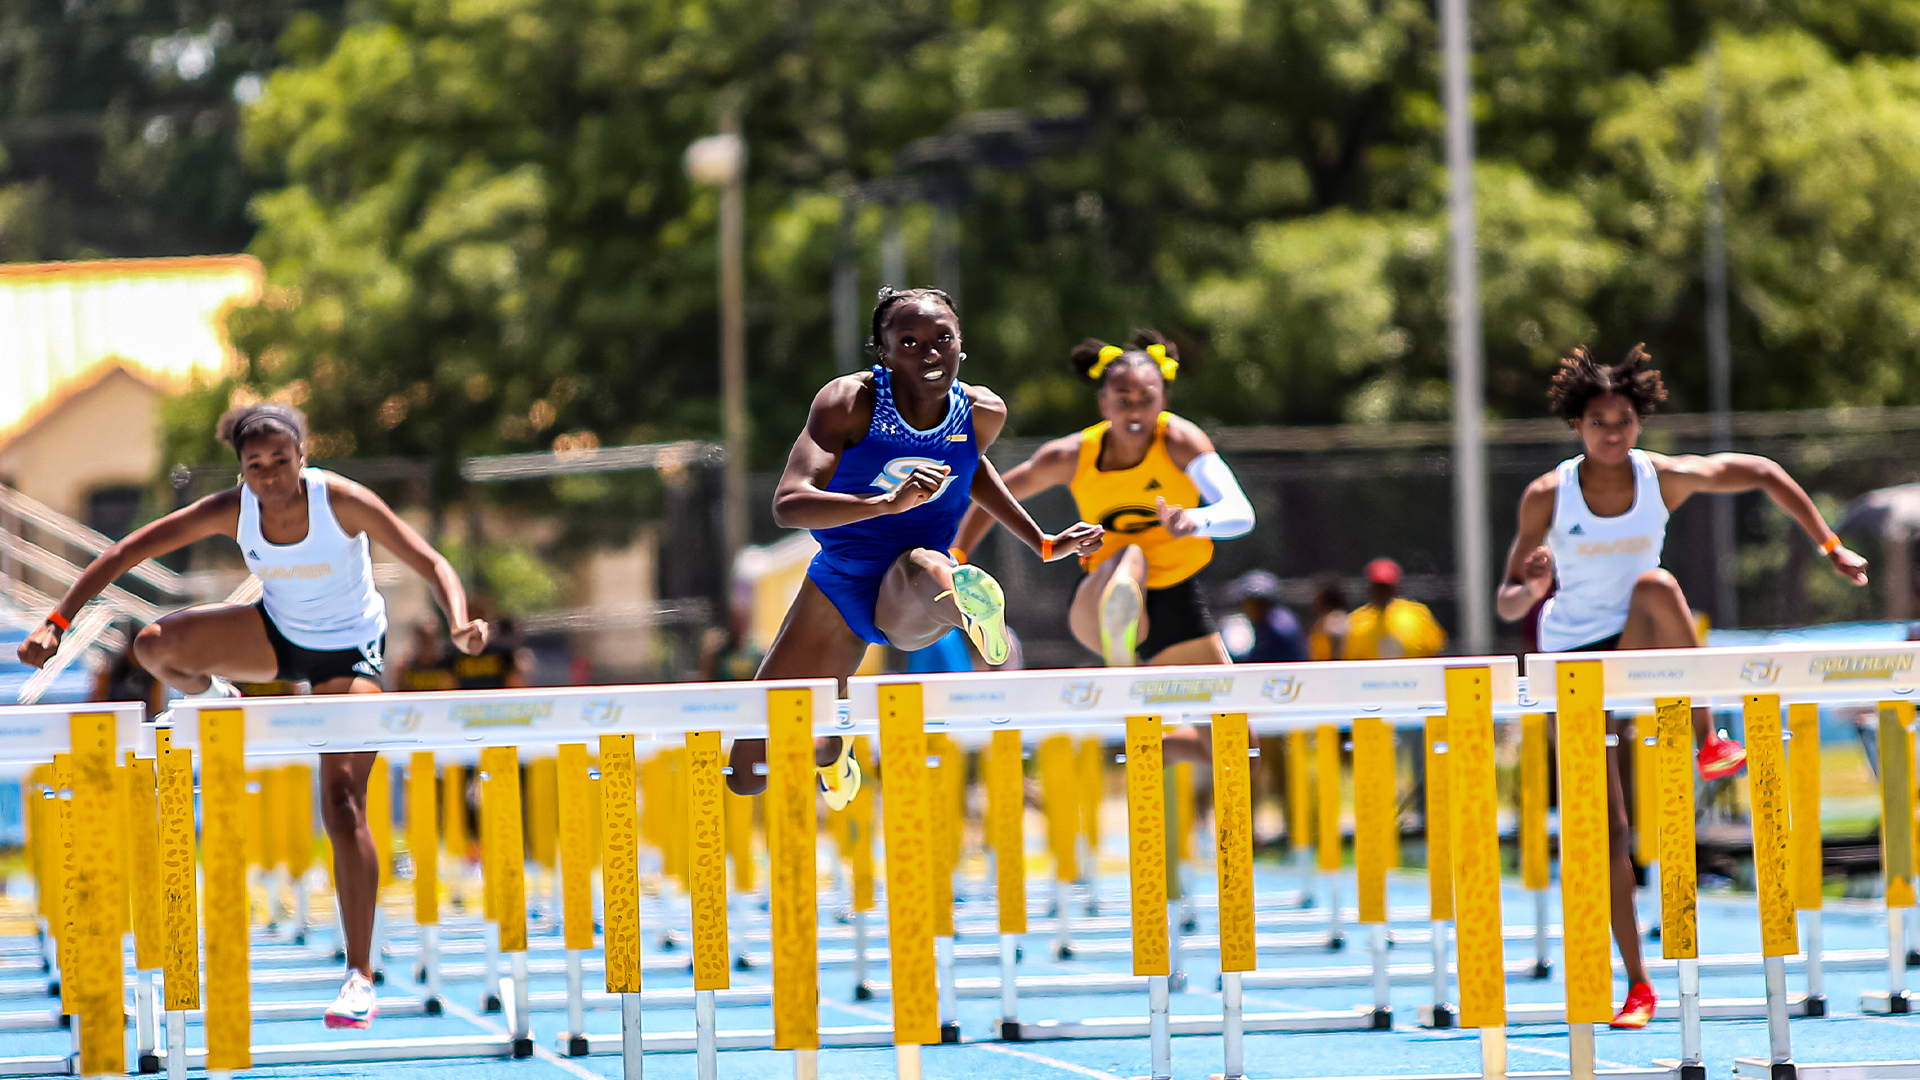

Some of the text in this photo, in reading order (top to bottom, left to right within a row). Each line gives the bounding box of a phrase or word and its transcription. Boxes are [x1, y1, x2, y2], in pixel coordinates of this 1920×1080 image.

[256, 562, 334, 579] XAVIER
[1810, 653, 1915, 675] SOUTHERN
[1130, 677, 1233, 698] SOUTHERN
